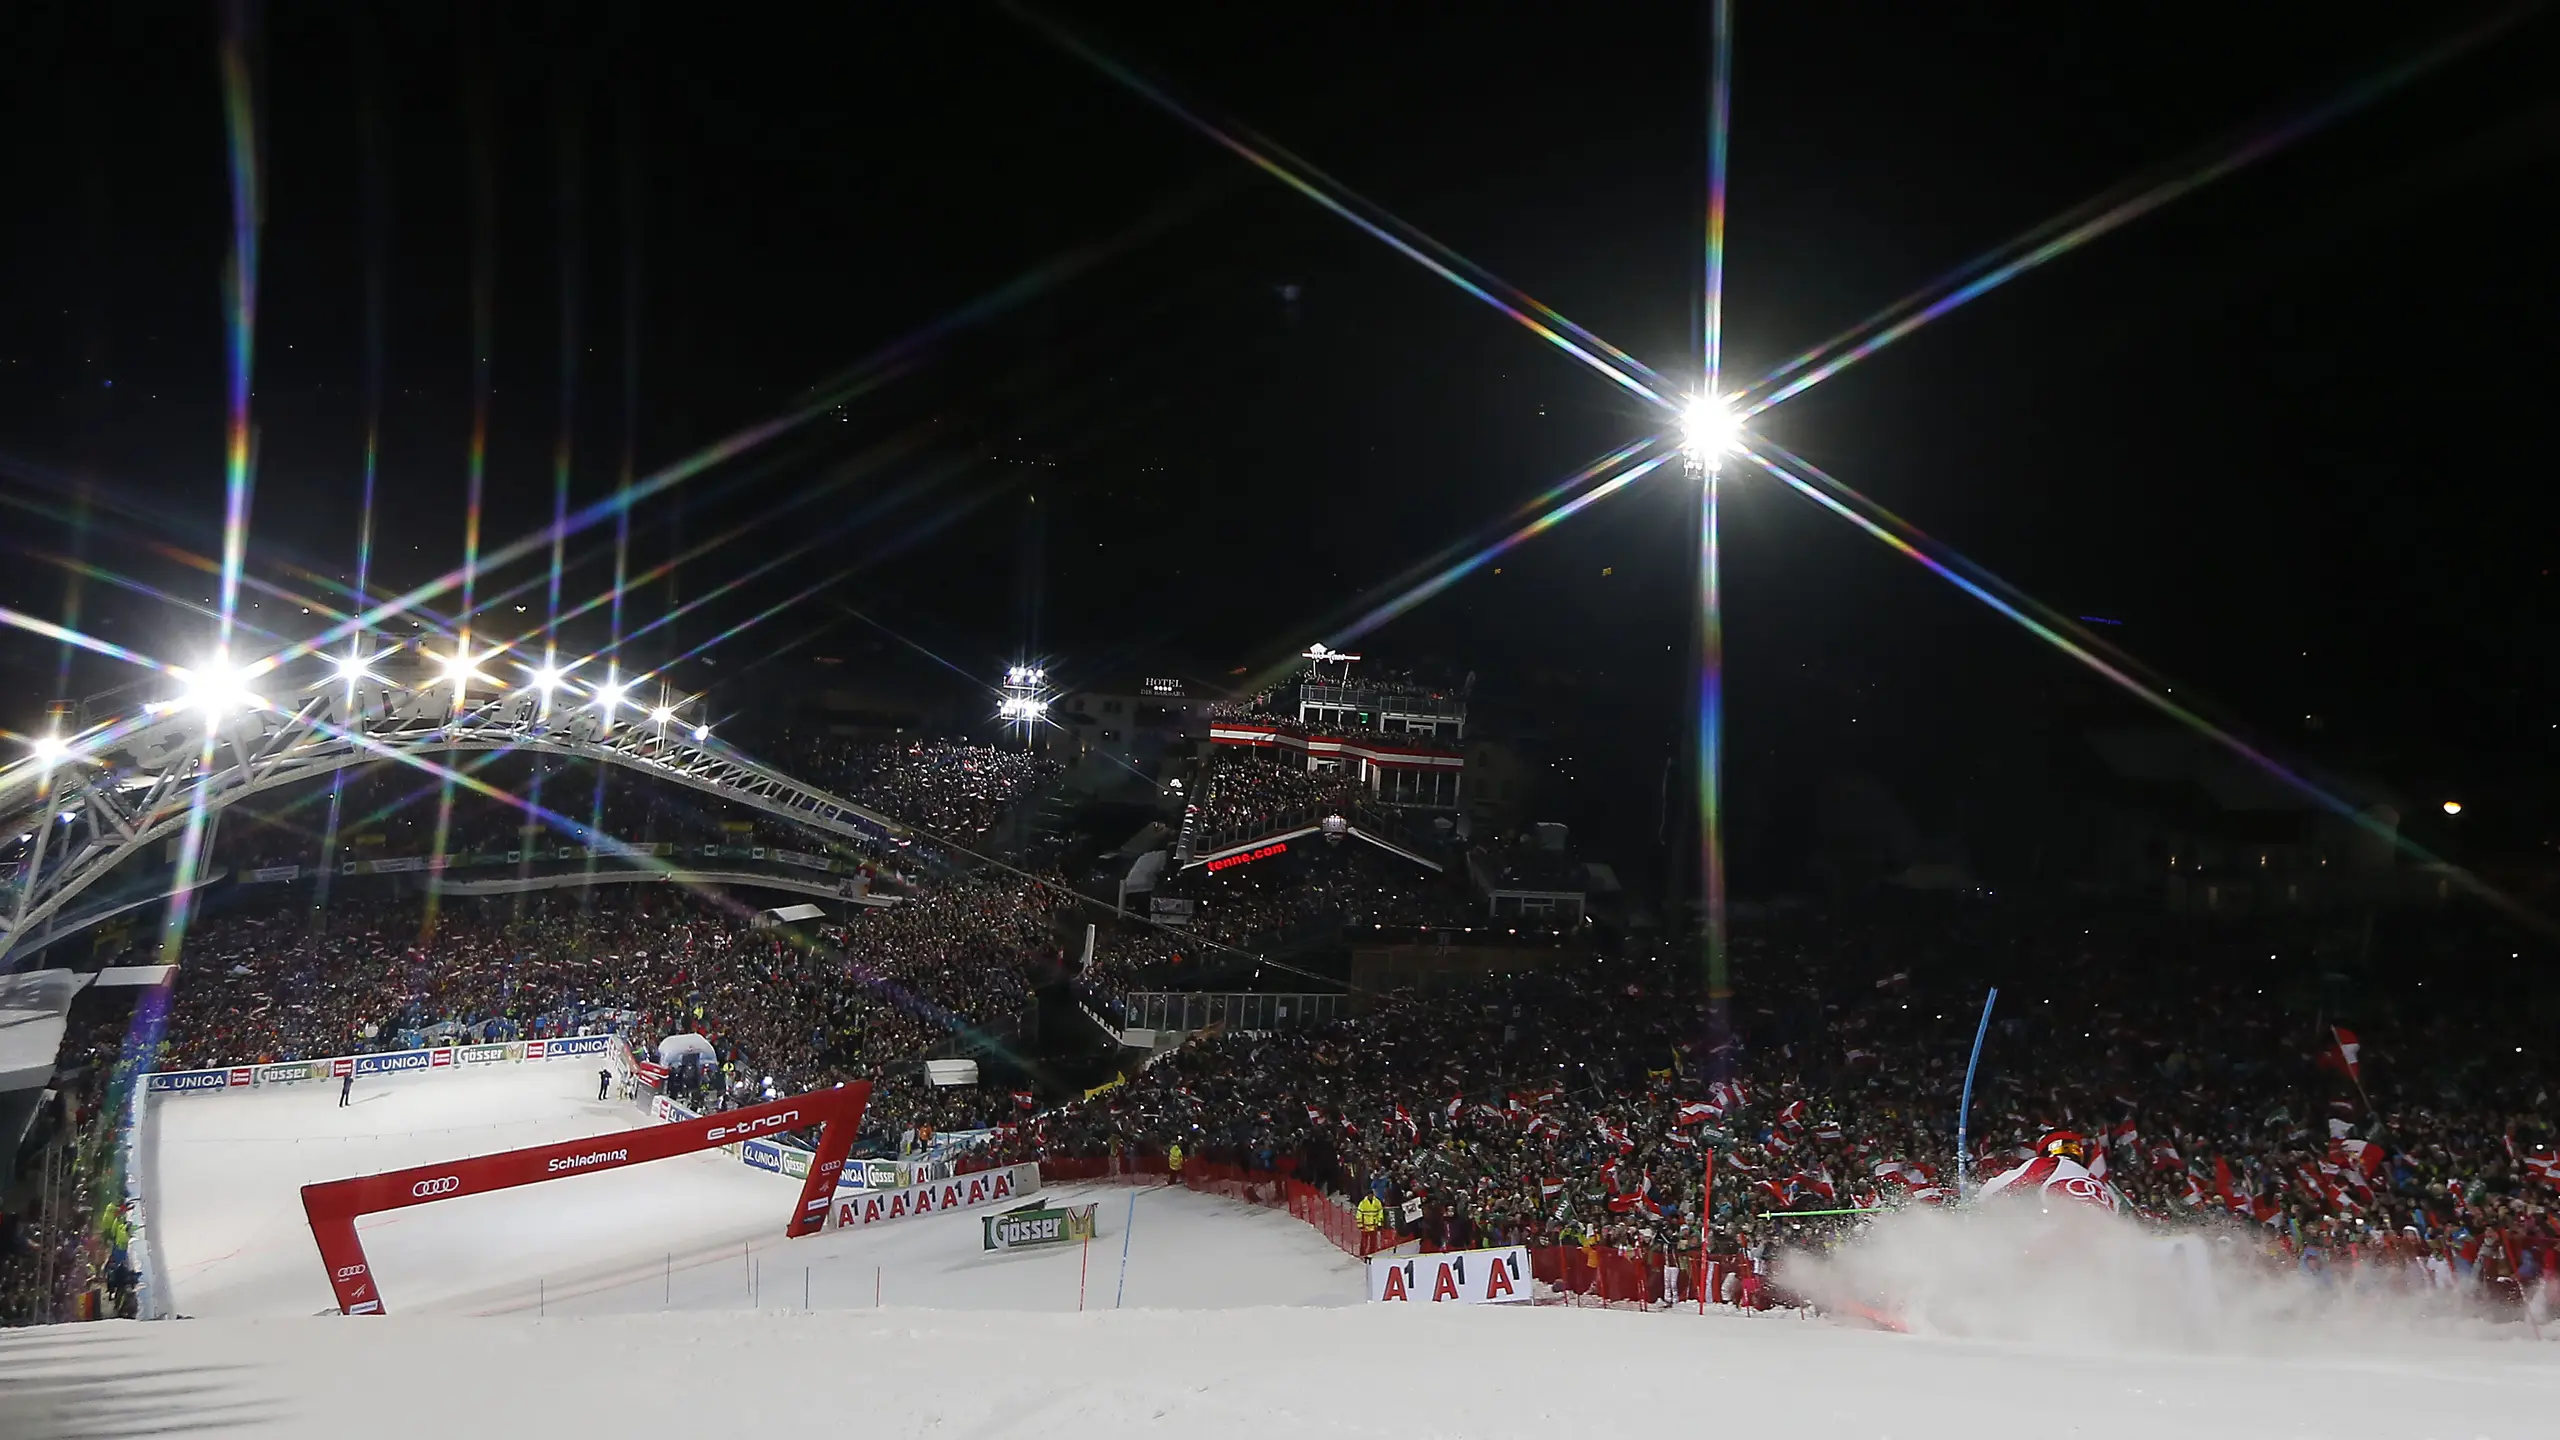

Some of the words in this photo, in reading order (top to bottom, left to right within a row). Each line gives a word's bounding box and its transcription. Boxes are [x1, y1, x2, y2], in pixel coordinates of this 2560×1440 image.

[1145, 677, 1183, 688] HOTEL
[1207, 842, 1288, 872] tenne.com
[457, 1047, 503, 1063] Gösser
[569, 1040, 610, 1054] UNIQA
[381, 1055, 428, 1070] UNIQA
[174, 1074, 225, 1089] UNIQA
[257, 1066, 308, 1082] Gösser
[707, 1109, 799, 1141] e-tron
[548, 1148, 628, 1172] Schladming
[754, 1151, 780, 1168] UNIQA
[783, 1153, 806, 1173] Gösser
[840, 1168, 864, 1183] NIQA
[868, 1164, 895, 1183] Gösser
[839, 1199, 859, 1228] A1
[864, 1194, 884, 1224] A1
[889, 1190, 911, 1219] A1
[914, 1185, 937, 1214] A1
[941, 1180, 964, 1209] A1
[967, 1174, 990, 1205] A1
[992, 1169, 1016, 1200] A1
[990, 1214, 1062, 1250] Gösser
[1382, 1259, 1415, 1302] A1
[1432, 1255, 1466, 1302] A1
[1486, 1251, 1520, 1300] A1
